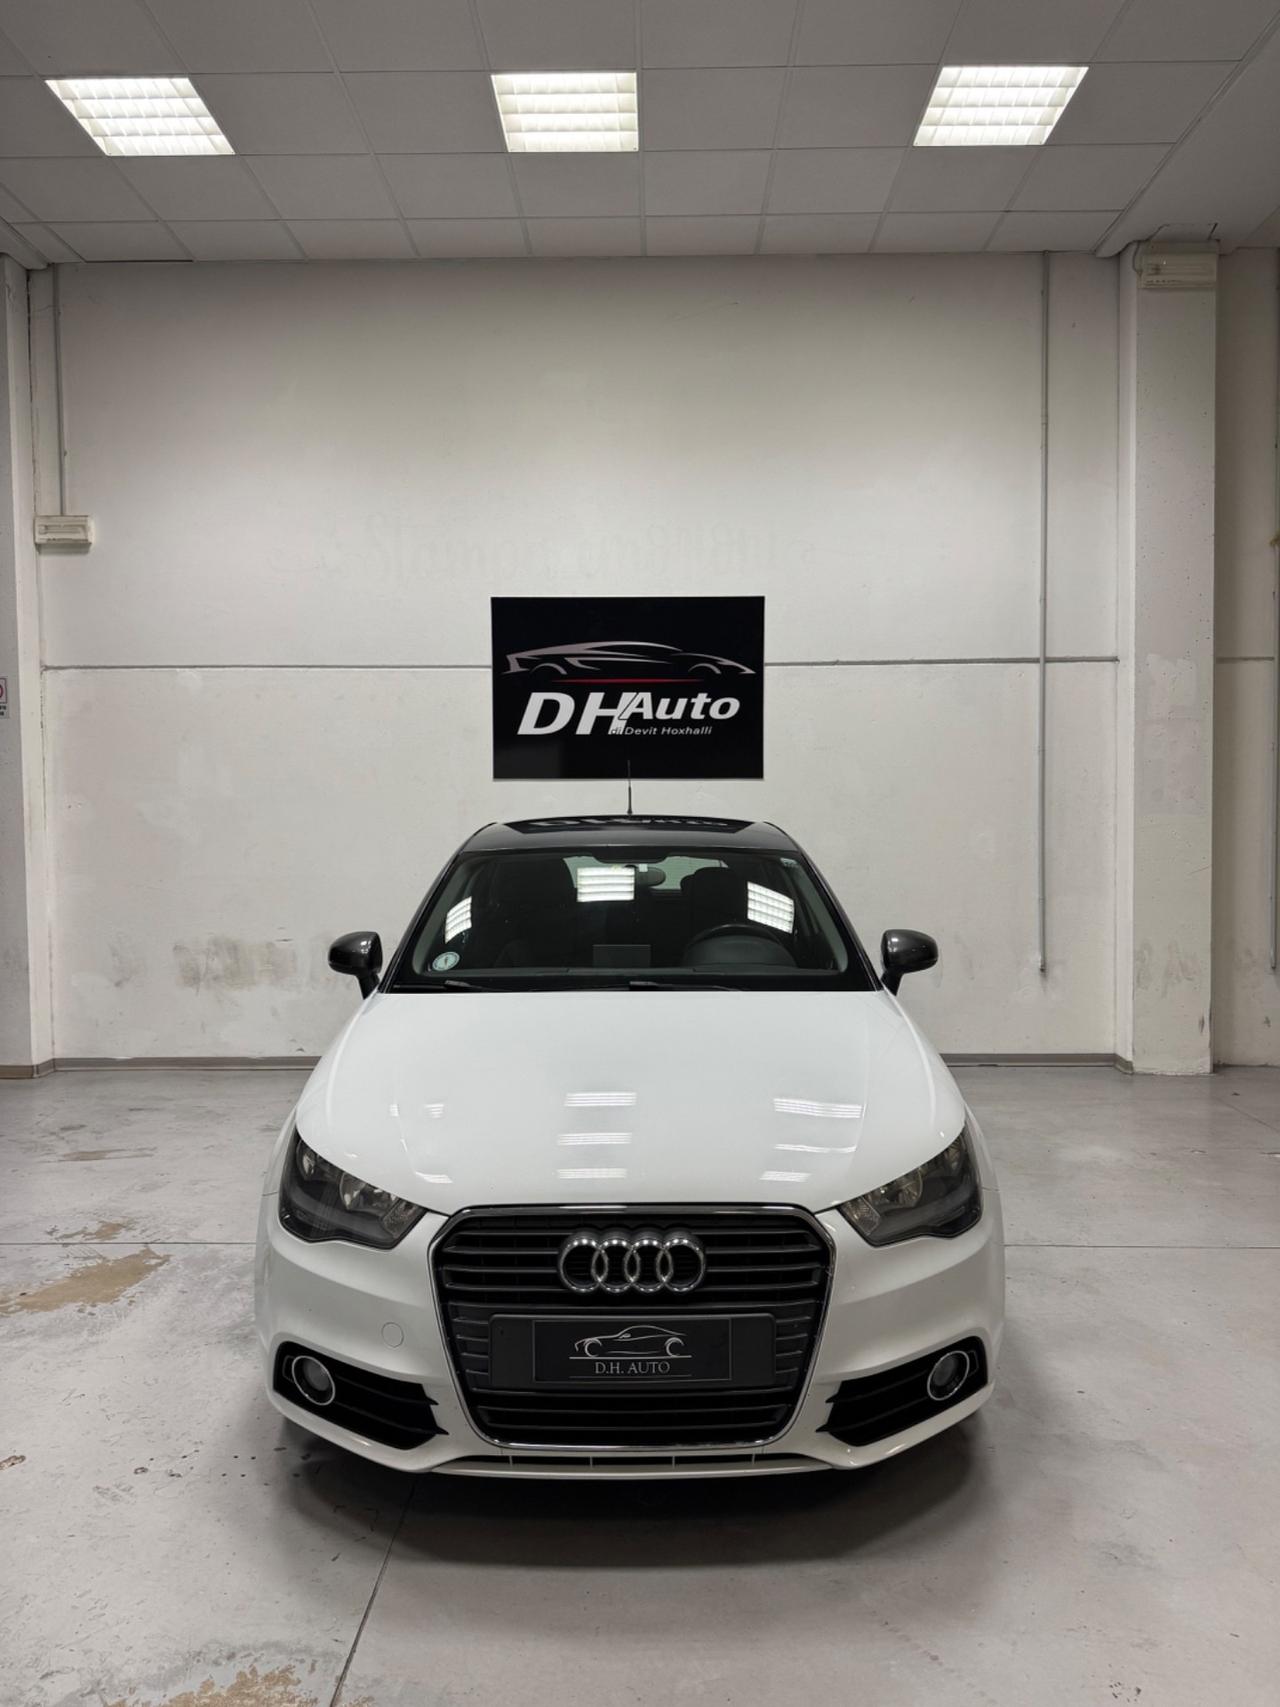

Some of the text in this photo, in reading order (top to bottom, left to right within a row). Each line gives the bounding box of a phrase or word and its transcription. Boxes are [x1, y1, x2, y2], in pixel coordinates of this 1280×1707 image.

[625, 727, 658, 735] Devit
[661, 726, 713, 735] Hoxhalli
[595, 1361, 671, 1374] D.H. AUTO
